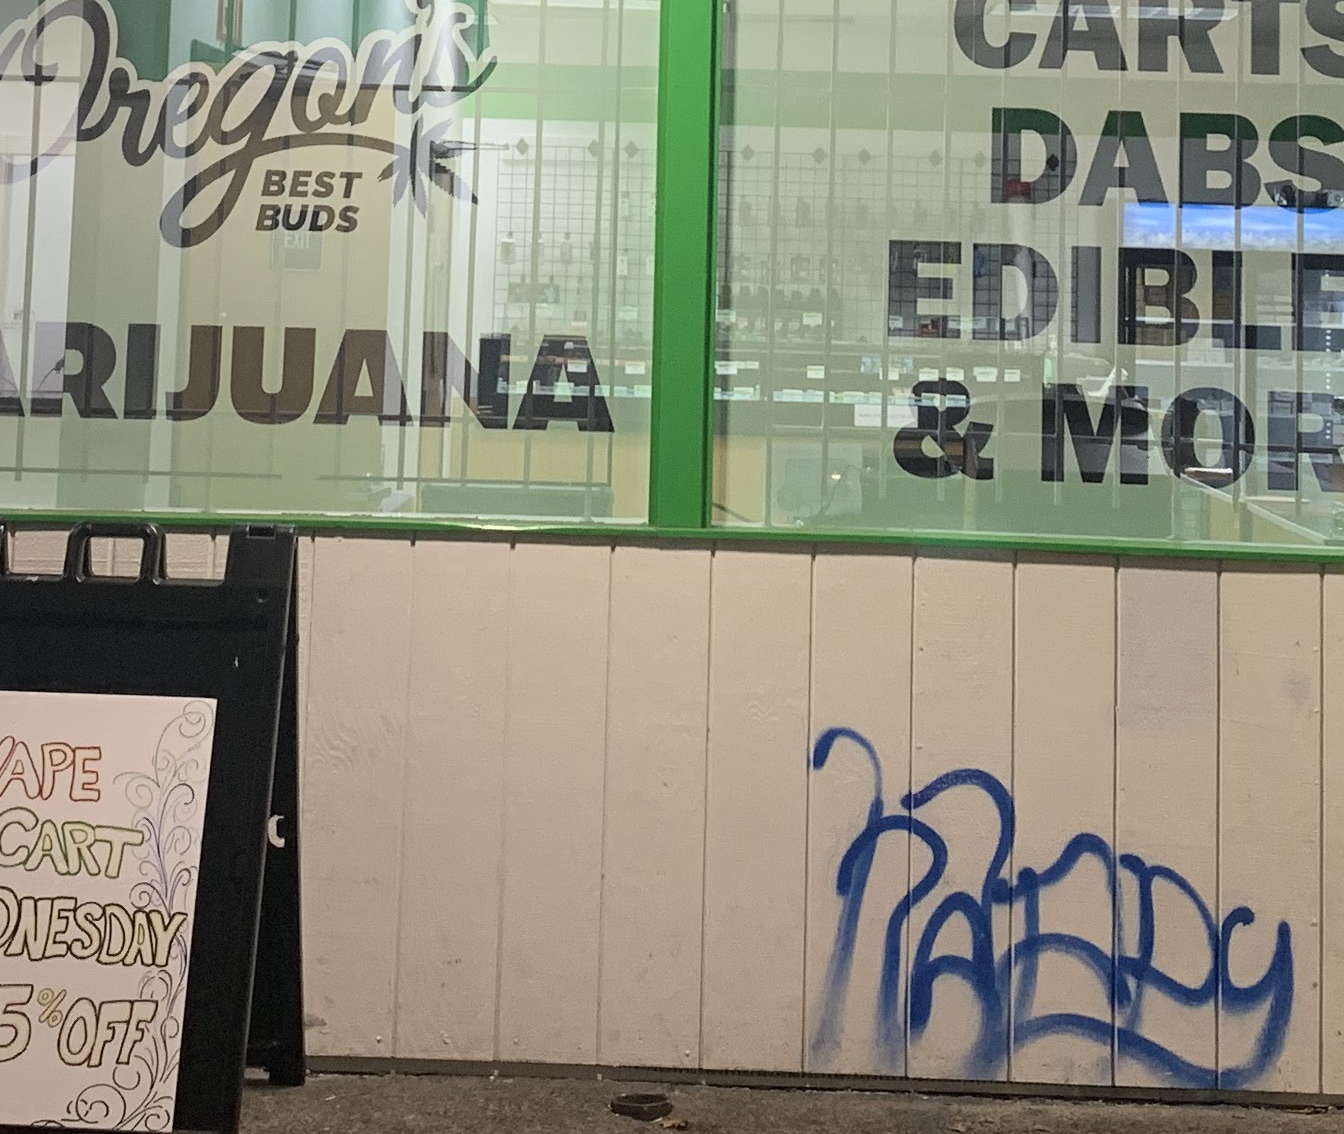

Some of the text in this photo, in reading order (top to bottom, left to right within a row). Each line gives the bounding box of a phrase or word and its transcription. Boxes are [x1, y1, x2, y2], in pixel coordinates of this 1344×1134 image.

[261, 169, 363, 199] BEST
[255, 204, 360, 233] BUDS
[894, 376, 995, 482] &
